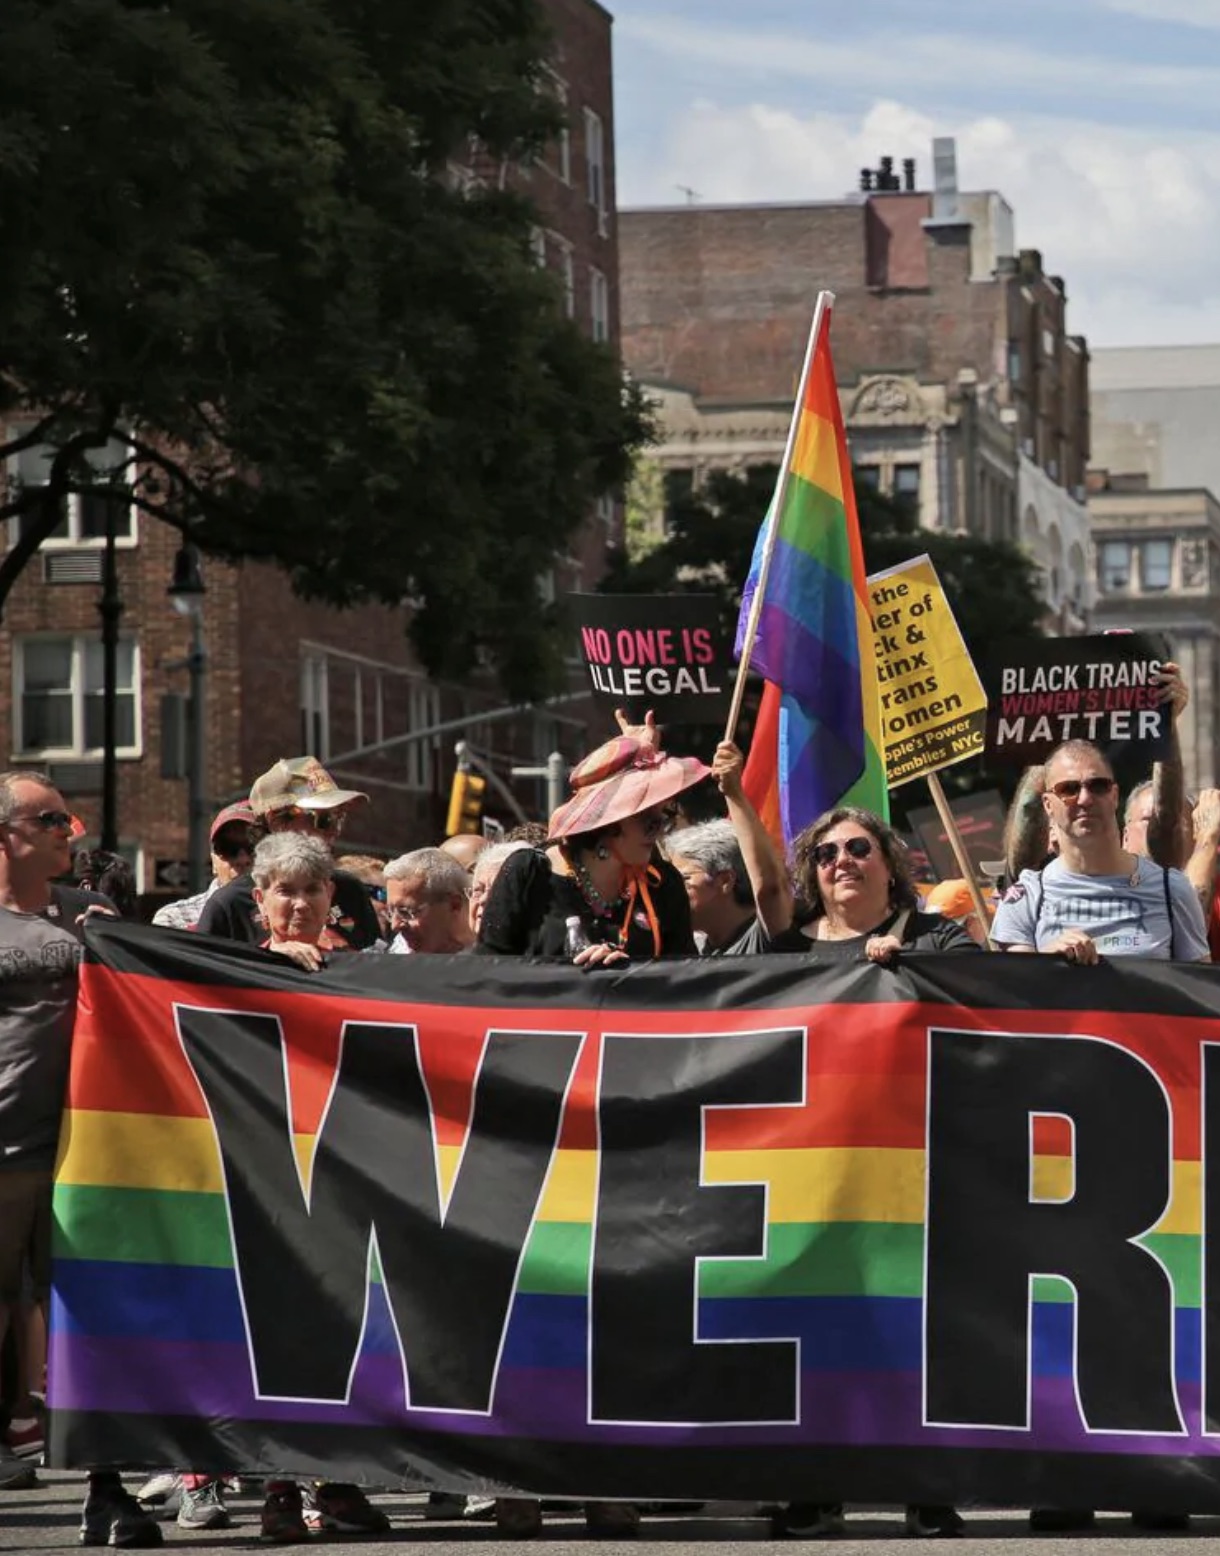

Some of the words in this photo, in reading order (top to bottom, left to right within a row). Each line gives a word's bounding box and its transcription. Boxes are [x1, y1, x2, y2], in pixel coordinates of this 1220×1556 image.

[871, 582, 909, 606] the
[909, 594, 934, 618] of
[581, 626, 612, 665] NO
[616, 628, 677, 666] ONE
[681, 628, 715, 665] IS
[589, 663, 722, 696] ILLEGAL
[1001, 664, 1080, 695] BLACK
[1085, 659, 1162, 690] TRANS
[882, 691, 963, 738] omen
[1001, 690, 1100, 717] WOMEN'S
[1104, 686, 1161, 711] LIVES
[925, 719, 971, 745] Power
[951, 730, 984, 754] NYC
[995, 710, 1163, 746] MATTER
[172, 1002, 808, 1428] WE
